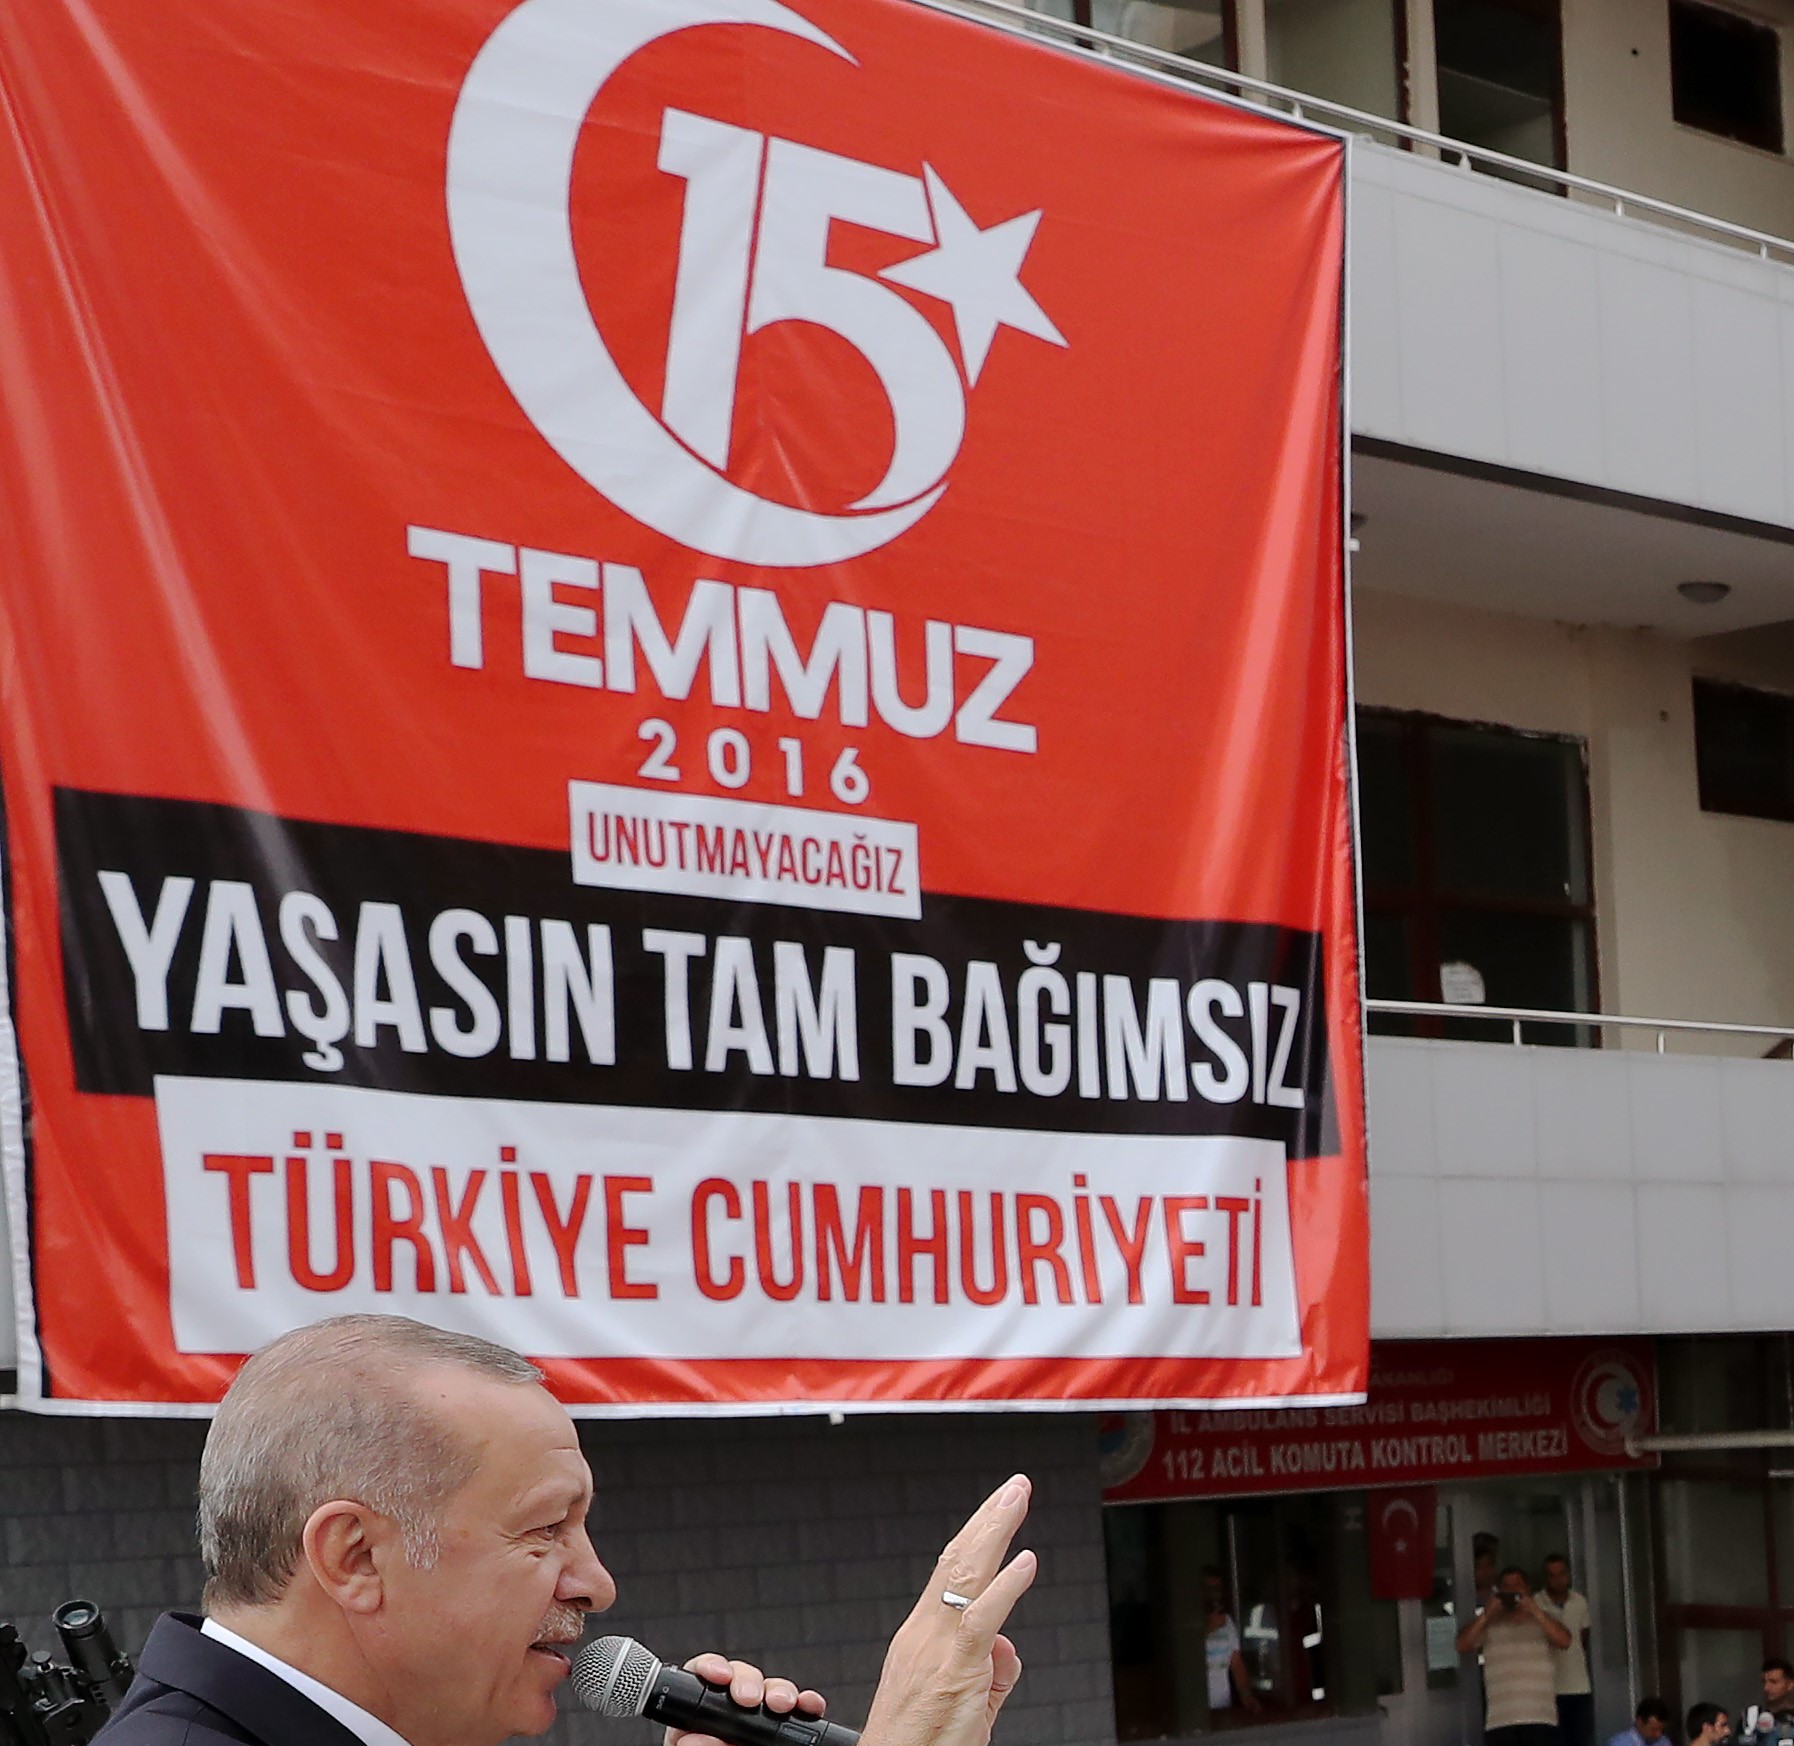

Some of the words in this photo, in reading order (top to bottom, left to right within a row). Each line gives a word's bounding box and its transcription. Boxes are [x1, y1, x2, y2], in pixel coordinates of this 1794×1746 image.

[657, 107, 968, 517] 15
[407, 523, 1037, 754] TEMMUZ
[637, 719, 872, 805] 2016
[587, 810, 906, 897] UNUTMAYACAĞIZ
[97, 869, 622, 1071] YAŞASIN
[643, 926, 861, 1083] TAM
[893, 939, 1306, 1109] BAĞIMSIZ
[203, 1130, 660, 1303] TÜRKİYE
[690, 1173, 1264, 1309] CUMHURİYETİ
[1163, 1449, 1205, 1481] 112
[1211, 1440, 1264, 1479] ACİL
[1270, 1441, 1366, 1476] KOMUTA
[1370, 1433, 1472, 1469] KONTROL
